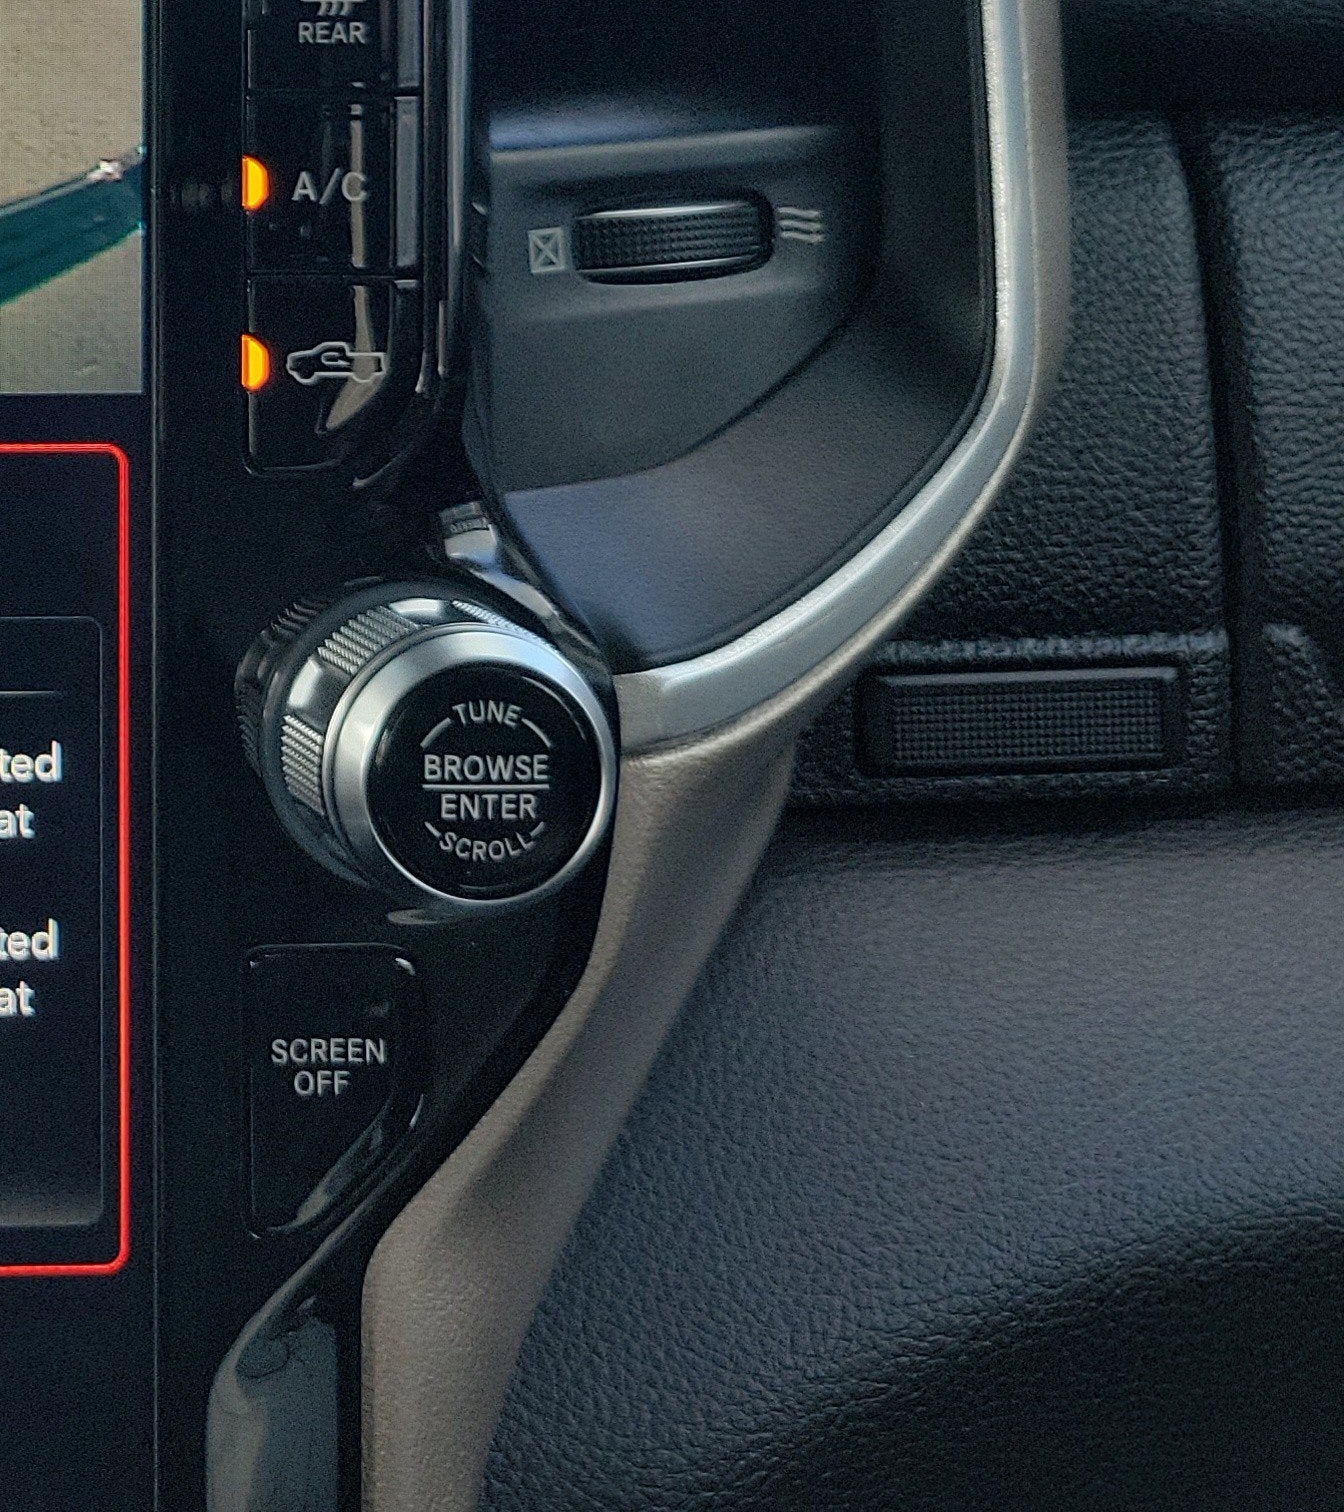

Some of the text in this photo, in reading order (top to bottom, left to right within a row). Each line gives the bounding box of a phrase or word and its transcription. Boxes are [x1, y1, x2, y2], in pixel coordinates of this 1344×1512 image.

[297, 22, 366, 45] REAR
[292, 167, 368, 204] A/C
[452, 700, 522, 728] TUNE
[423, 754, 550, 782] BROWSE
[439, 793, 536, 821] ENTER
[439, 829, 535, 862] SCROLL
[270, 1038, 386, 1066] SCREEN
[292, 1069, 350, 1097] OFF
